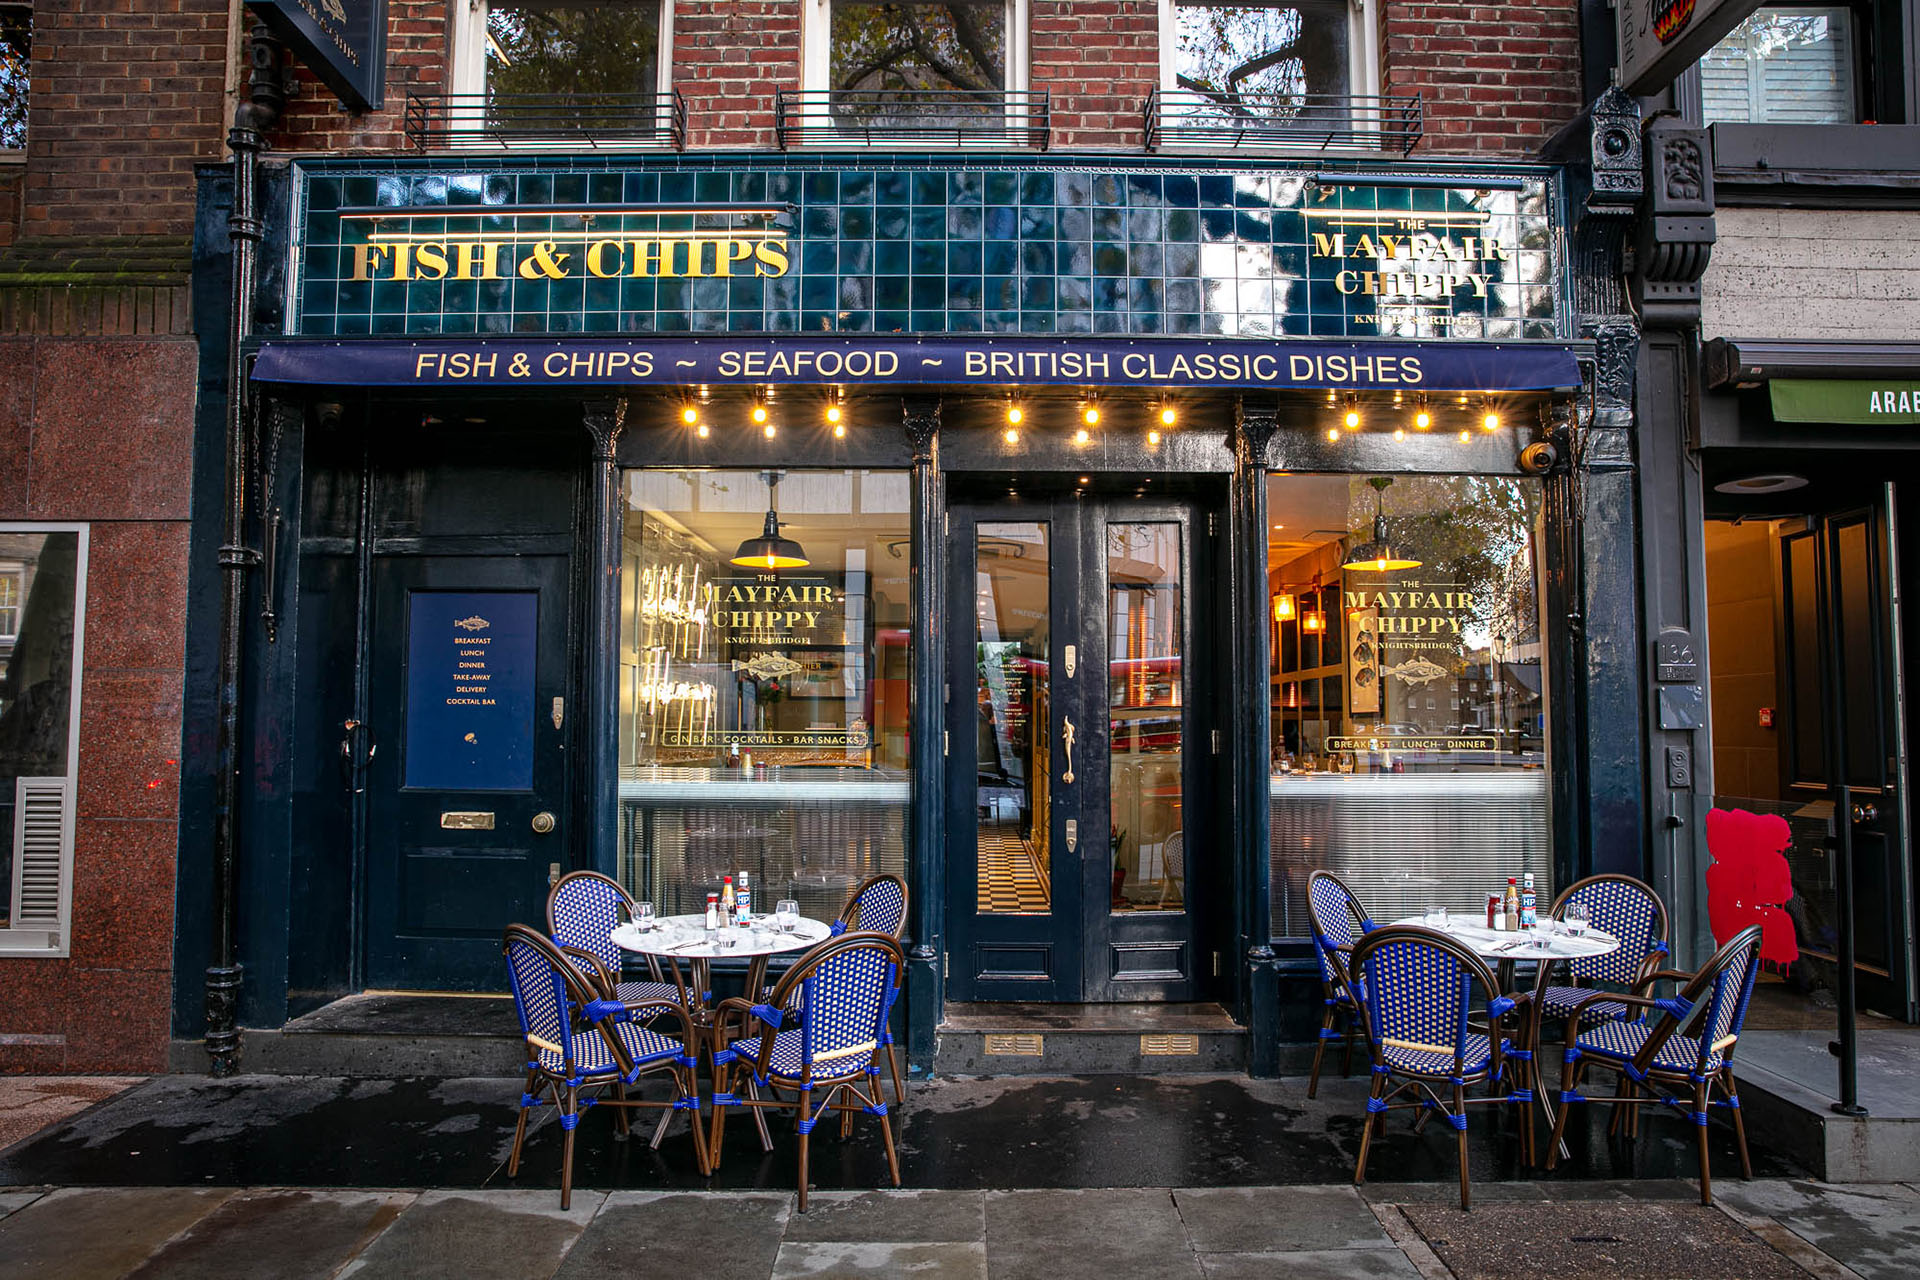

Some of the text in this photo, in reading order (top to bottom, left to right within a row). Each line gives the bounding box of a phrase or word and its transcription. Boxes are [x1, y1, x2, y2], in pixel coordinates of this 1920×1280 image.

[1397, 218, 1426, 231] THE
[1311, 232, 1512, 262] MAYFAIR
[348, 238, 789, 281] FISH & CHIPS
[1334, 269, 1493, 299] CHIPPY
[415, 352, 498, 379] FISH
[508, 351, 531, 378] &
[543, 350, 655, 378] CHIPS
[718, 350, 899, 377] SEAFOOD
[965, 351, 1109, 378] BRITISH
[1122, 353, 1278, 381] CLASSIC
[1289, 355, 1423, 383] DISHES
[757, 574, 777, 582] THE
[1401, 580, 1420, 588] THE
[701, 586, 835, 603] MAYFAIR
[1345, 591, 1475, 609] MAYFAIR
[712, 611, 821, 628] CHIPPY
[1359, 616, 1463, 634] CHIPPY
[454, 637, 492, 645] BREAKFAST
[724, 636, 810, 645] KNIGHTSBRIDGE
[1662, 644, 1694, 664] 136
[724, 735, 784, 744] COCKTAILS
[793, 736, 814, 744] BAR
[817, 736, 860, 745] SNACKS
[1402, 741, 1438, 749] LUNCH
[1448, 741, 1486, 749] DINNER
[1523, 898, 1536, 906] HP
